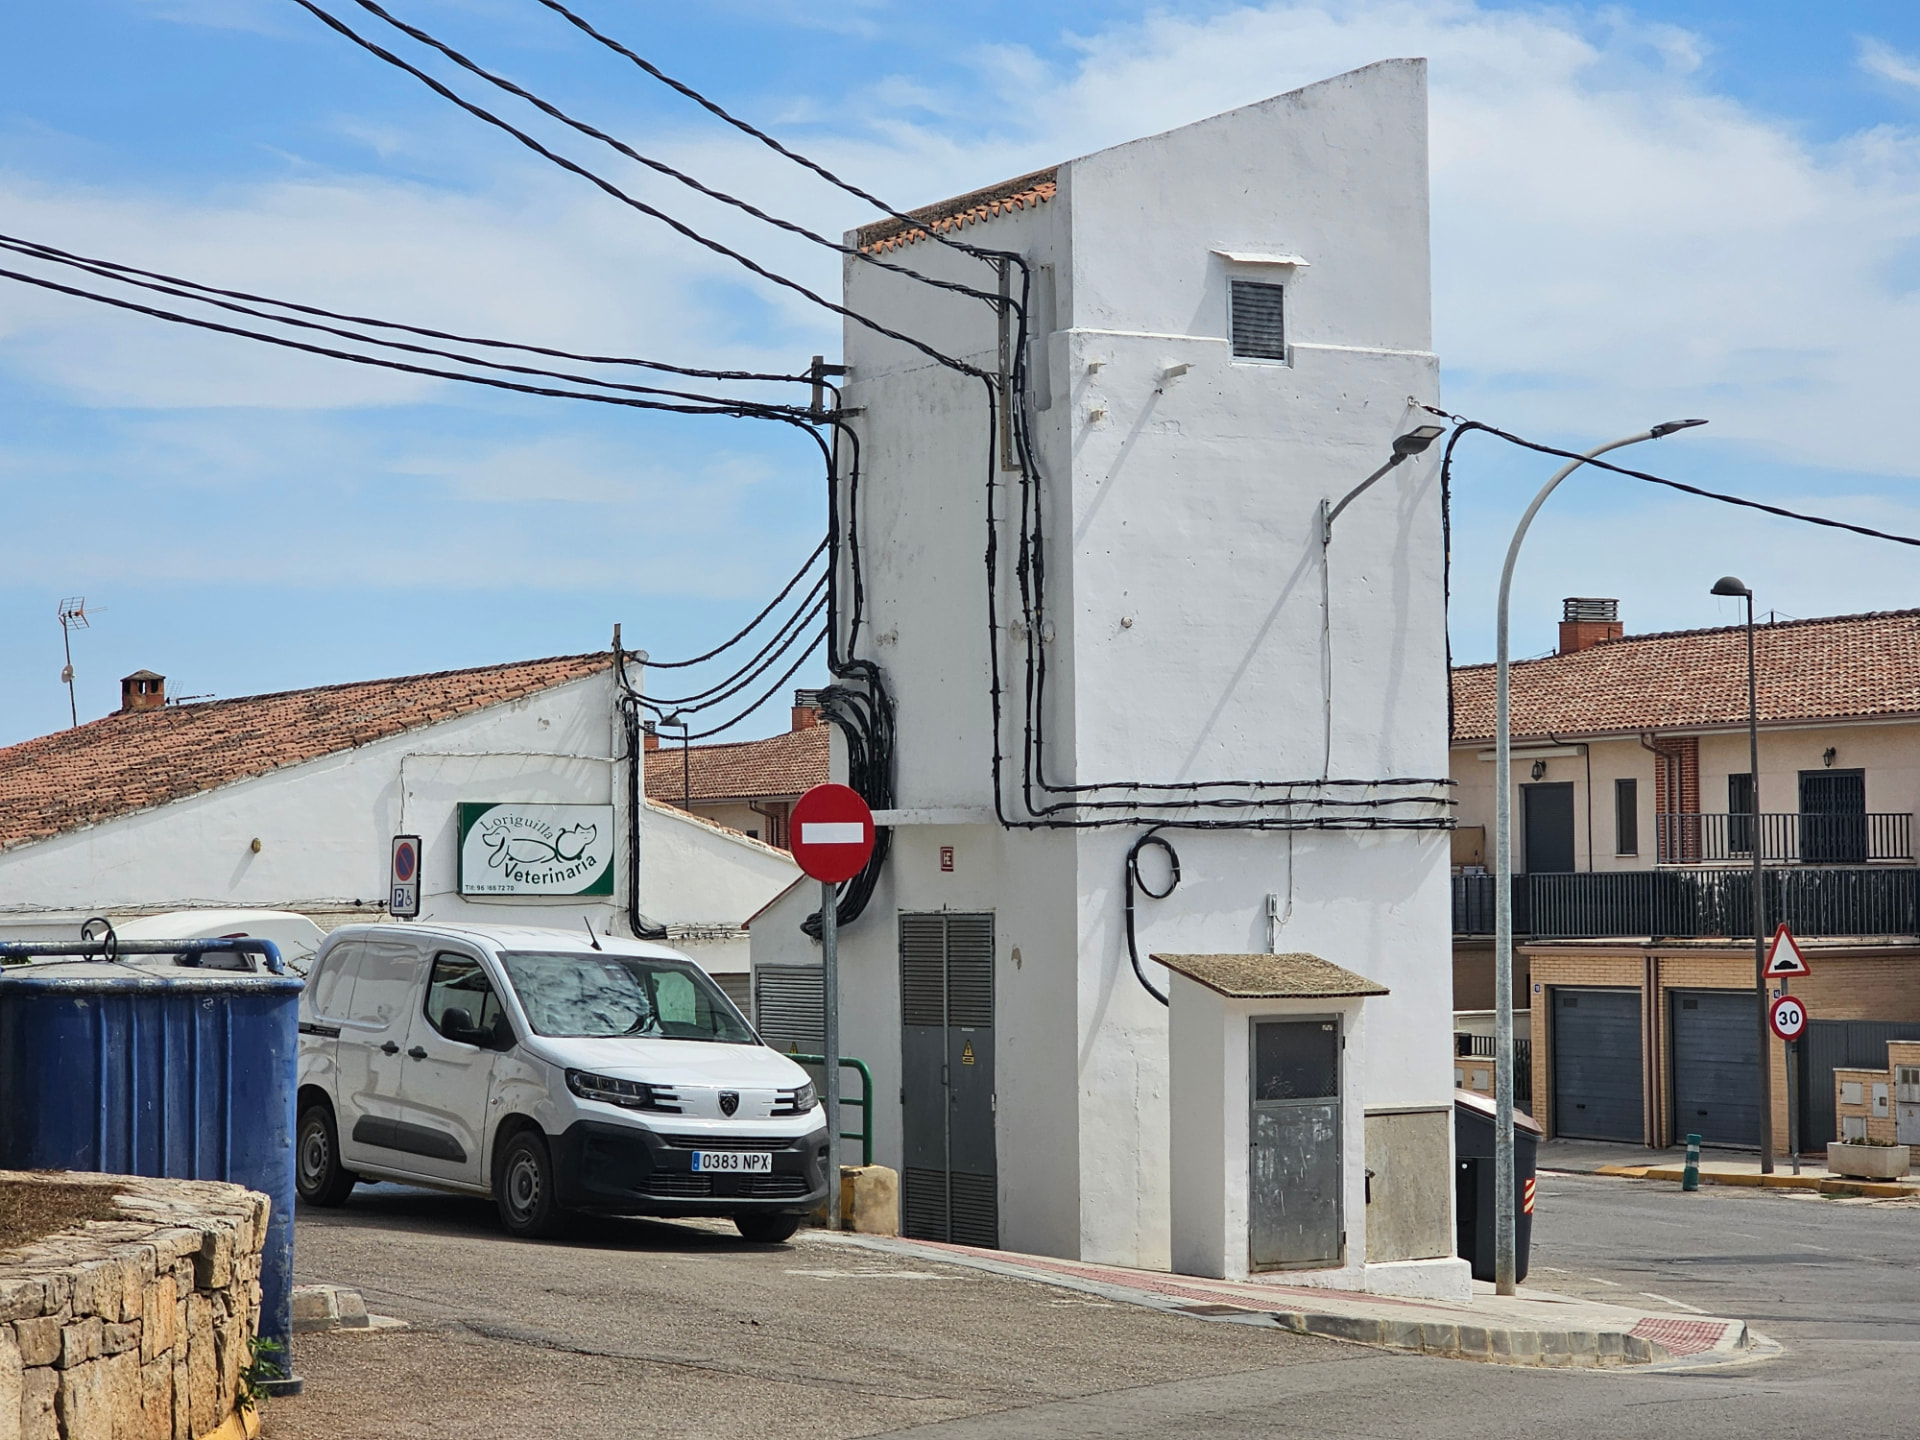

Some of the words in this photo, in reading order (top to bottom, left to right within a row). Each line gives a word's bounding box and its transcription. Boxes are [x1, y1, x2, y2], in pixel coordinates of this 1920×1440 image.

[480, 813, 553, 840] Loriguilla
[505, 855, 597, 884] Veterinaria
[395, 889, 403, 907] P
[1779, 1010, 1799, 1026] 30
[703, 1154, 738, 1169] 0383
[743, 1155, 769, 1170] NPX
